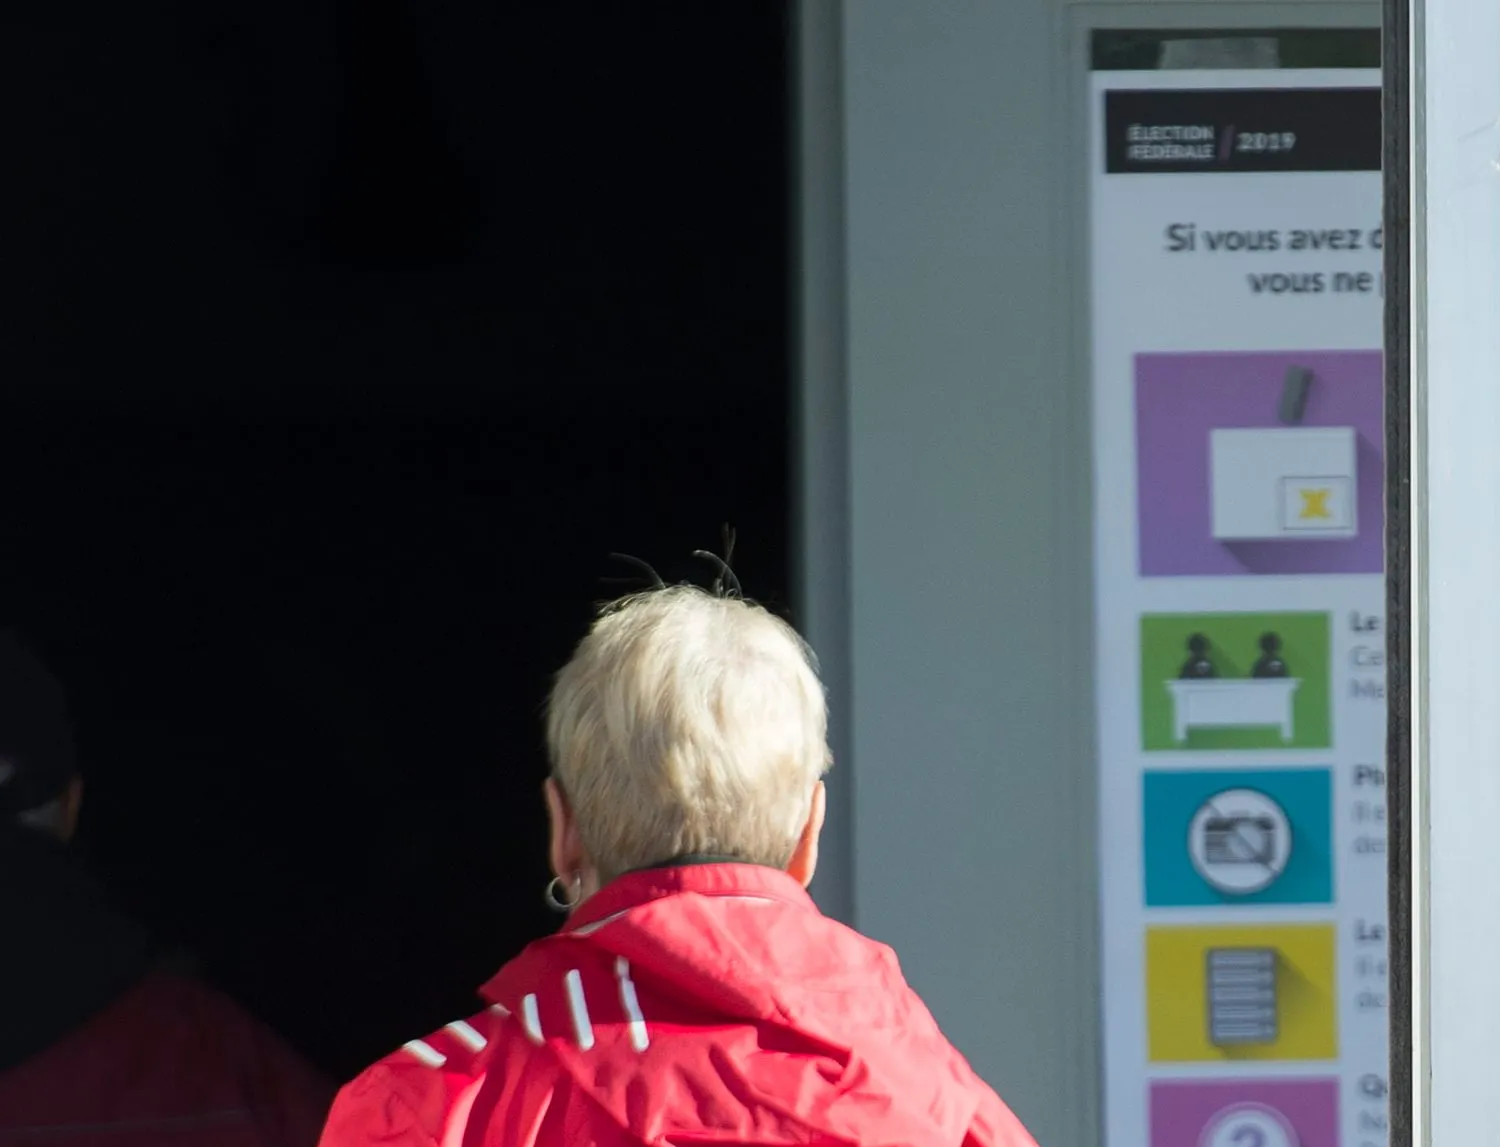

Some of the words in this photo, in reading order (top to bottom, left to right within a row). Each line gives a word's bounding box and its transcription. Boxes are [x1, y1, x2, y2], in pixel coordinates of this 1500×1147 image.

[1237, 131, 1296, 151] 2019
[1166, 223, 1196, 251] Si
[1203, 229, 1278, 251] vous
[1290, 228, 1362, 250] avez
[1248, 272, 1324, 293] vous
[1332, 271, 1374, 292] ne
